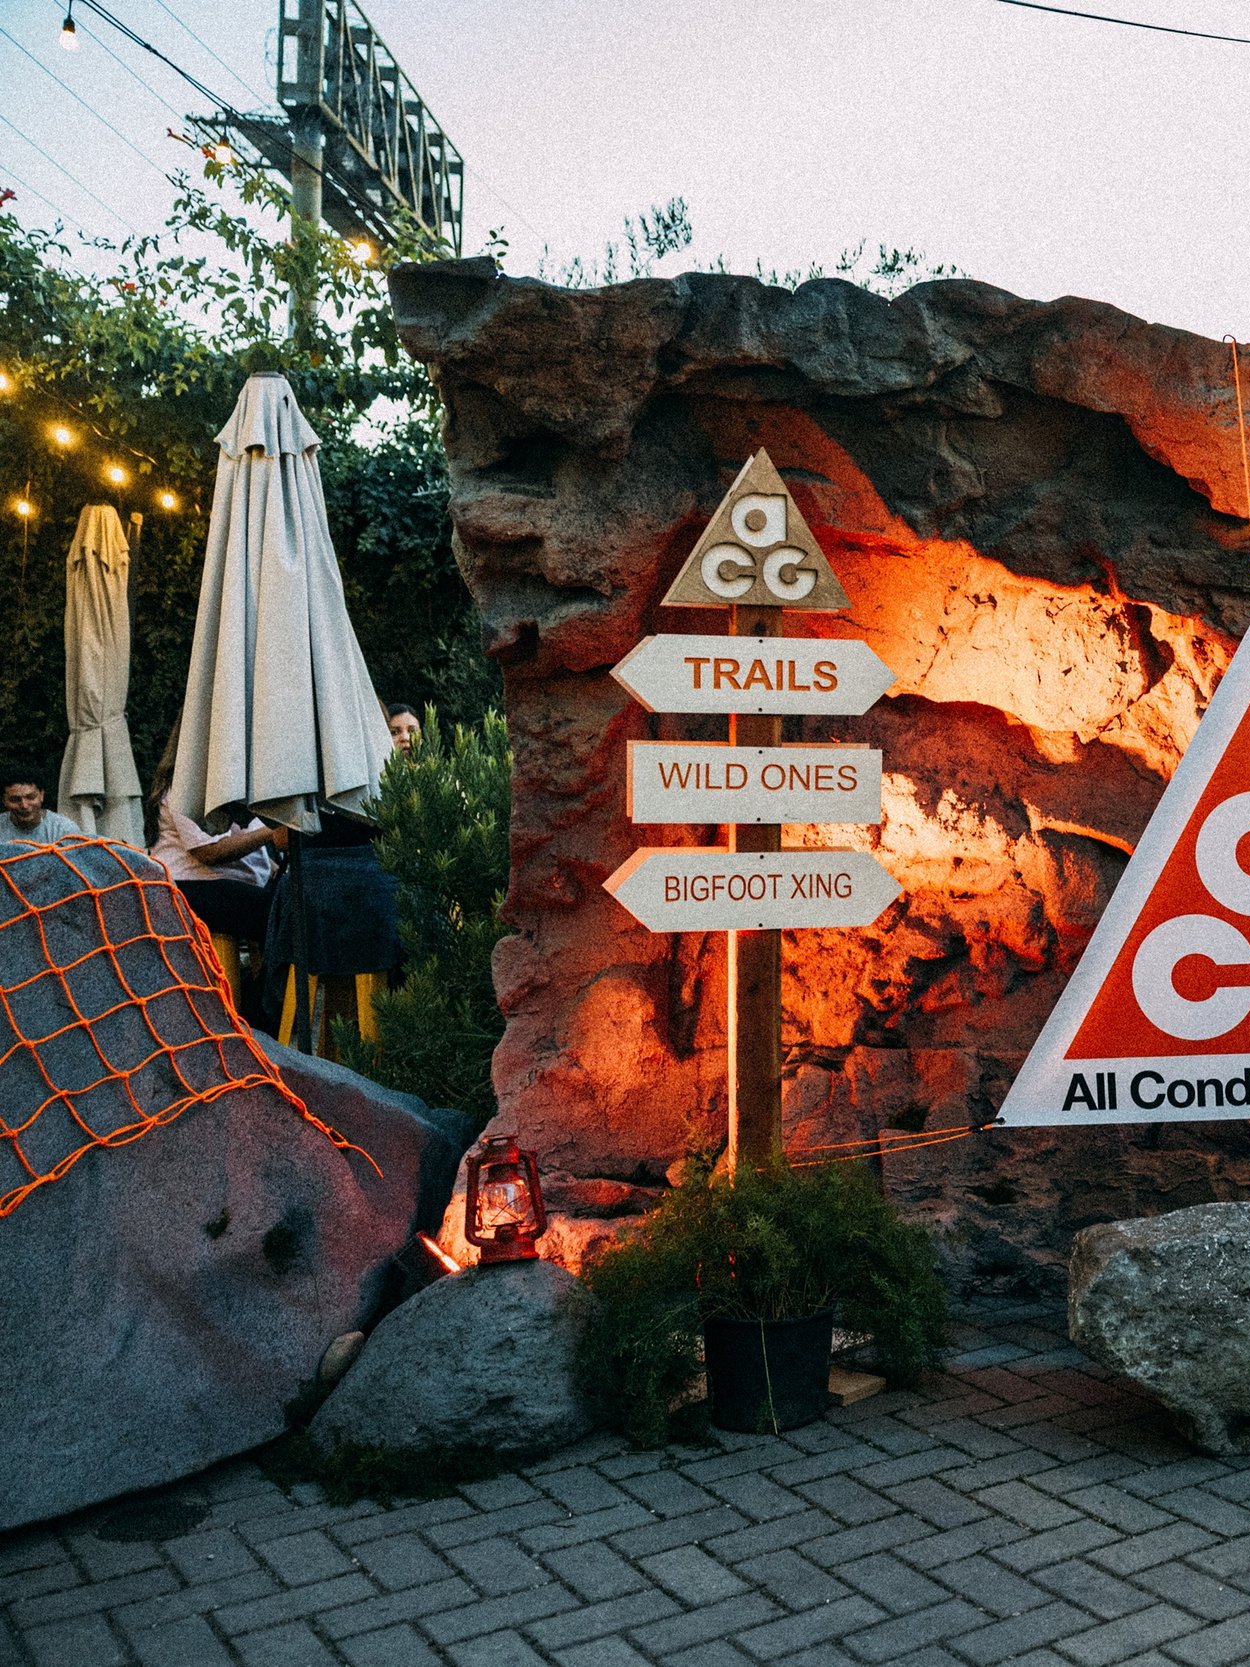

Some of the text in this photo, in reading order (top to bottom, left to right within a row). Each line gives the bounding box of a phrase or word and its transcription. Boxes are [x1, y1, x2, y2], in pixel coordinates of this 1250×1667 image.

[683, 656, 840, 694] TRAILS
[657, 761, 860, 793] WILD ONES
[663, 872, 854, 904] BIGFOOT XING
[1061, 1072, 1118, 1112] All
